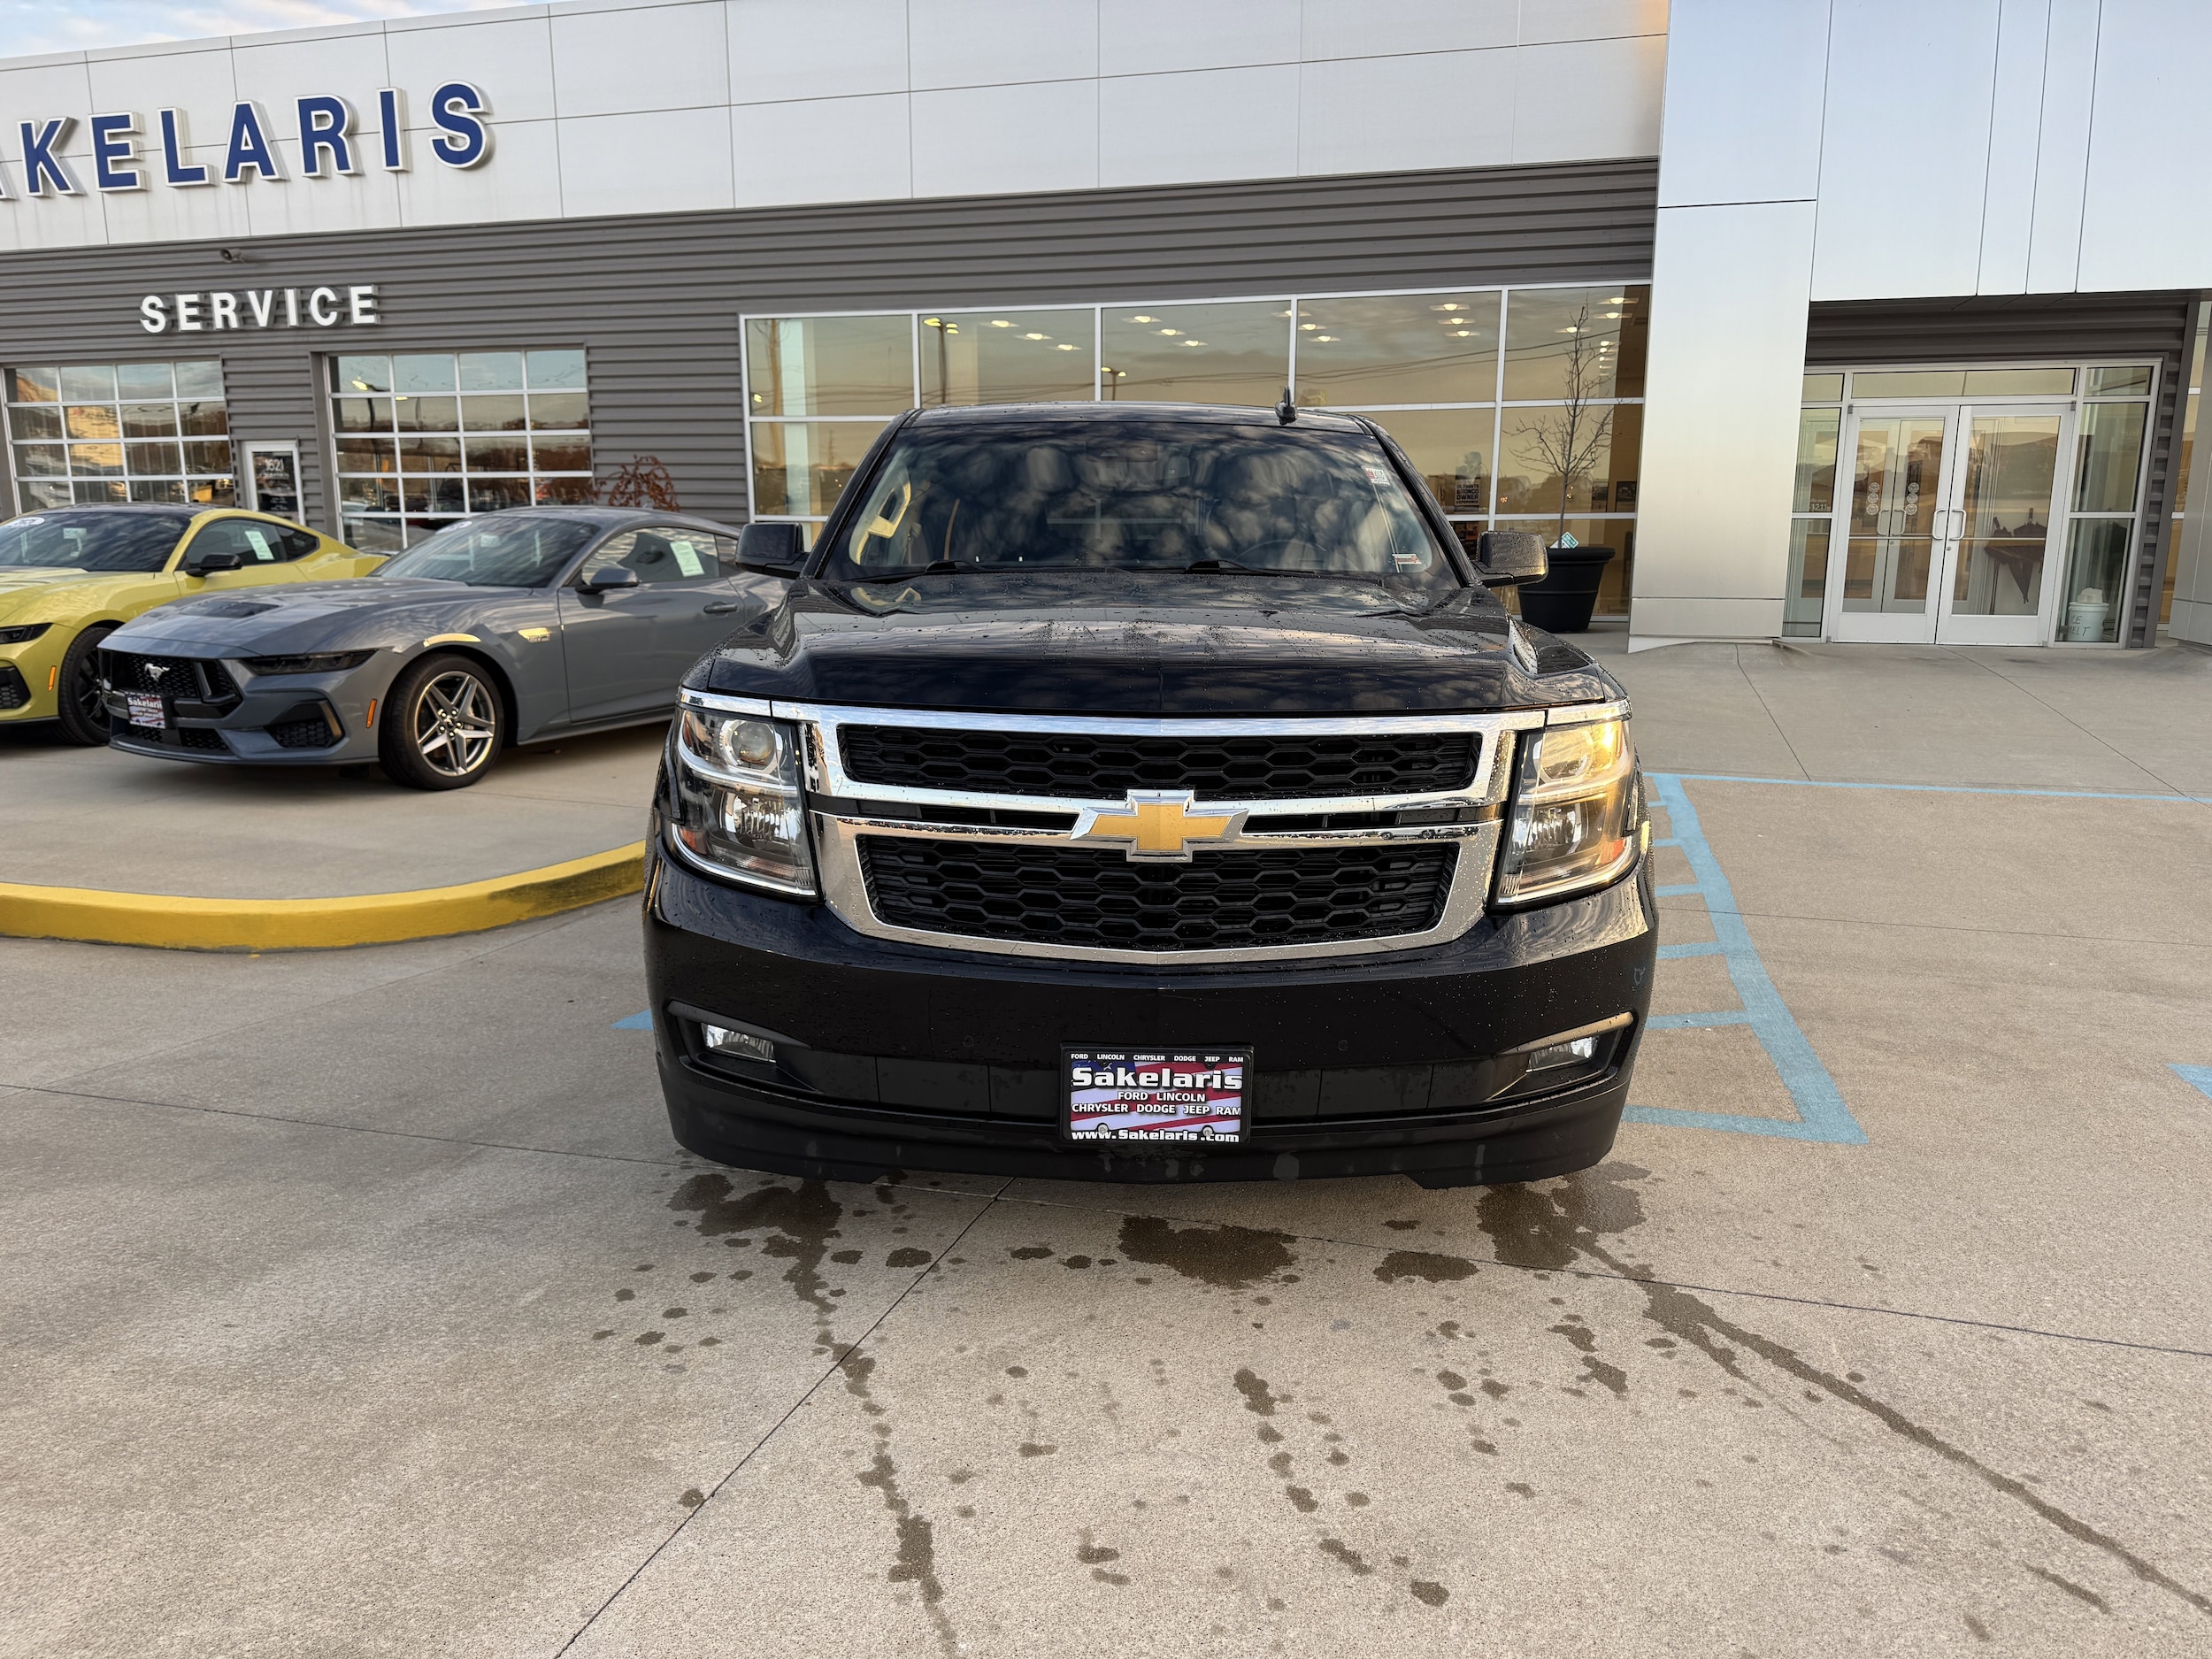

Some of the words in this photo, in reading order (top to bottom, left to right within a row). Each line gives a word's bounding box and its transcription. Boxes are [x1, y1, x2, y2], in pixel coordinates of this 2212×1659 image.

[0, 80, 493, 199] KELARIS
[140, 285, 379, 334] SERVICE
[1071, 1066, 1243, 1090] Sakelaris
[1118, 1091, 1148, 1101] FORD
[1156, 1091, 1206, 1102] LINCOLN
[1071, 1103, 1129, 1113] CHRYSLER
[1136, 1104, 1176, 1114] DODGE
[1183, 1105, 1210, 1115] JEEP
[1216, 1106, 1241, 1117] RAM
